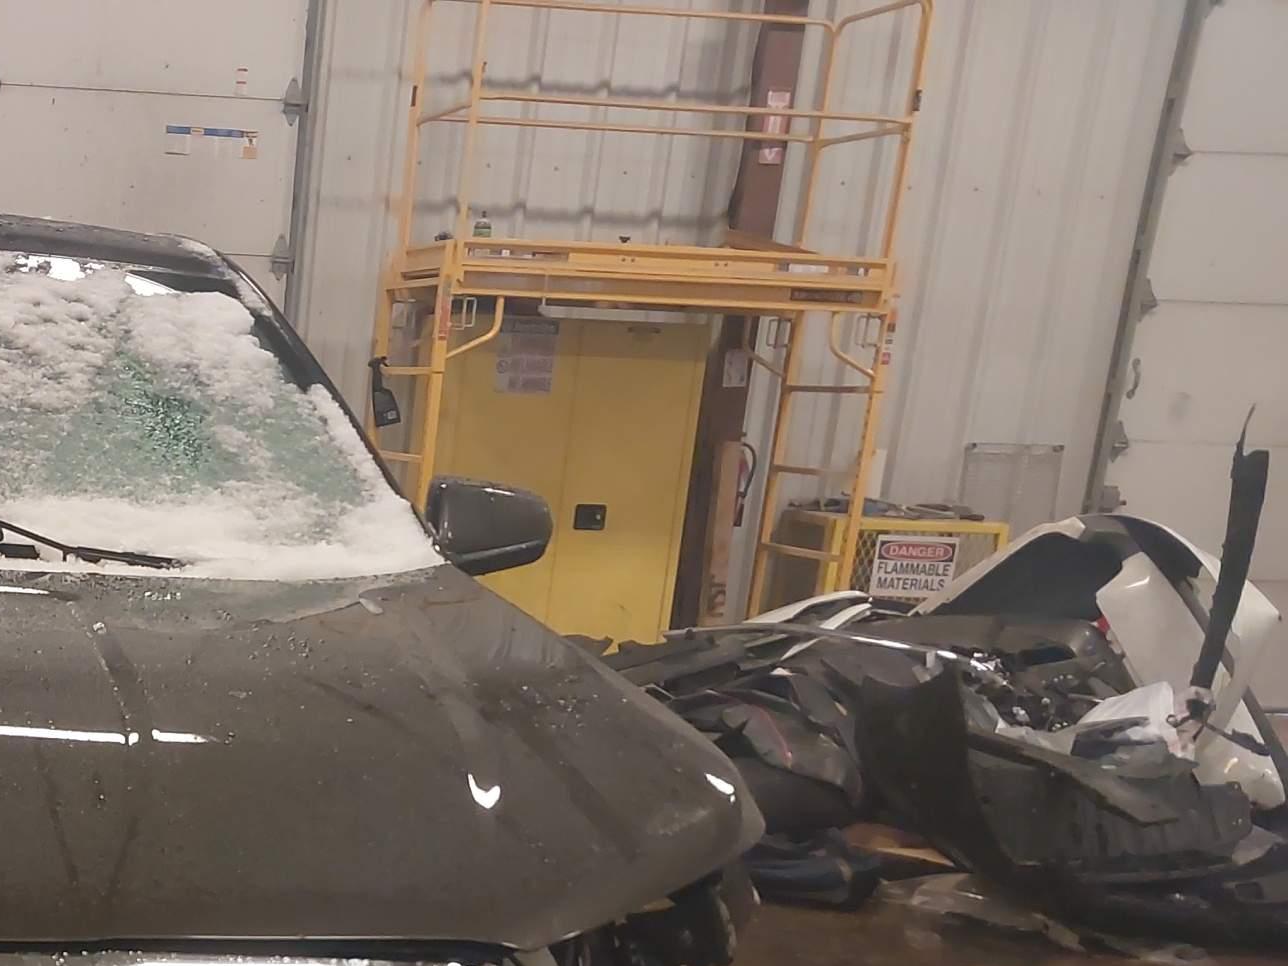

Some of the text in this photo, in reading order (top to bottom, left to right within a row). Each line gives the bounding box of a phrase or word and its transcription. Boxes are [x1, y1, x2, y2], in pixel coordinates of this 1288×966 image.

[889, 545, 945, 558] DANGER
[877, 562, 951, 577] FLAMMABLE
[876, 576, 945, 592] MATERIALS
